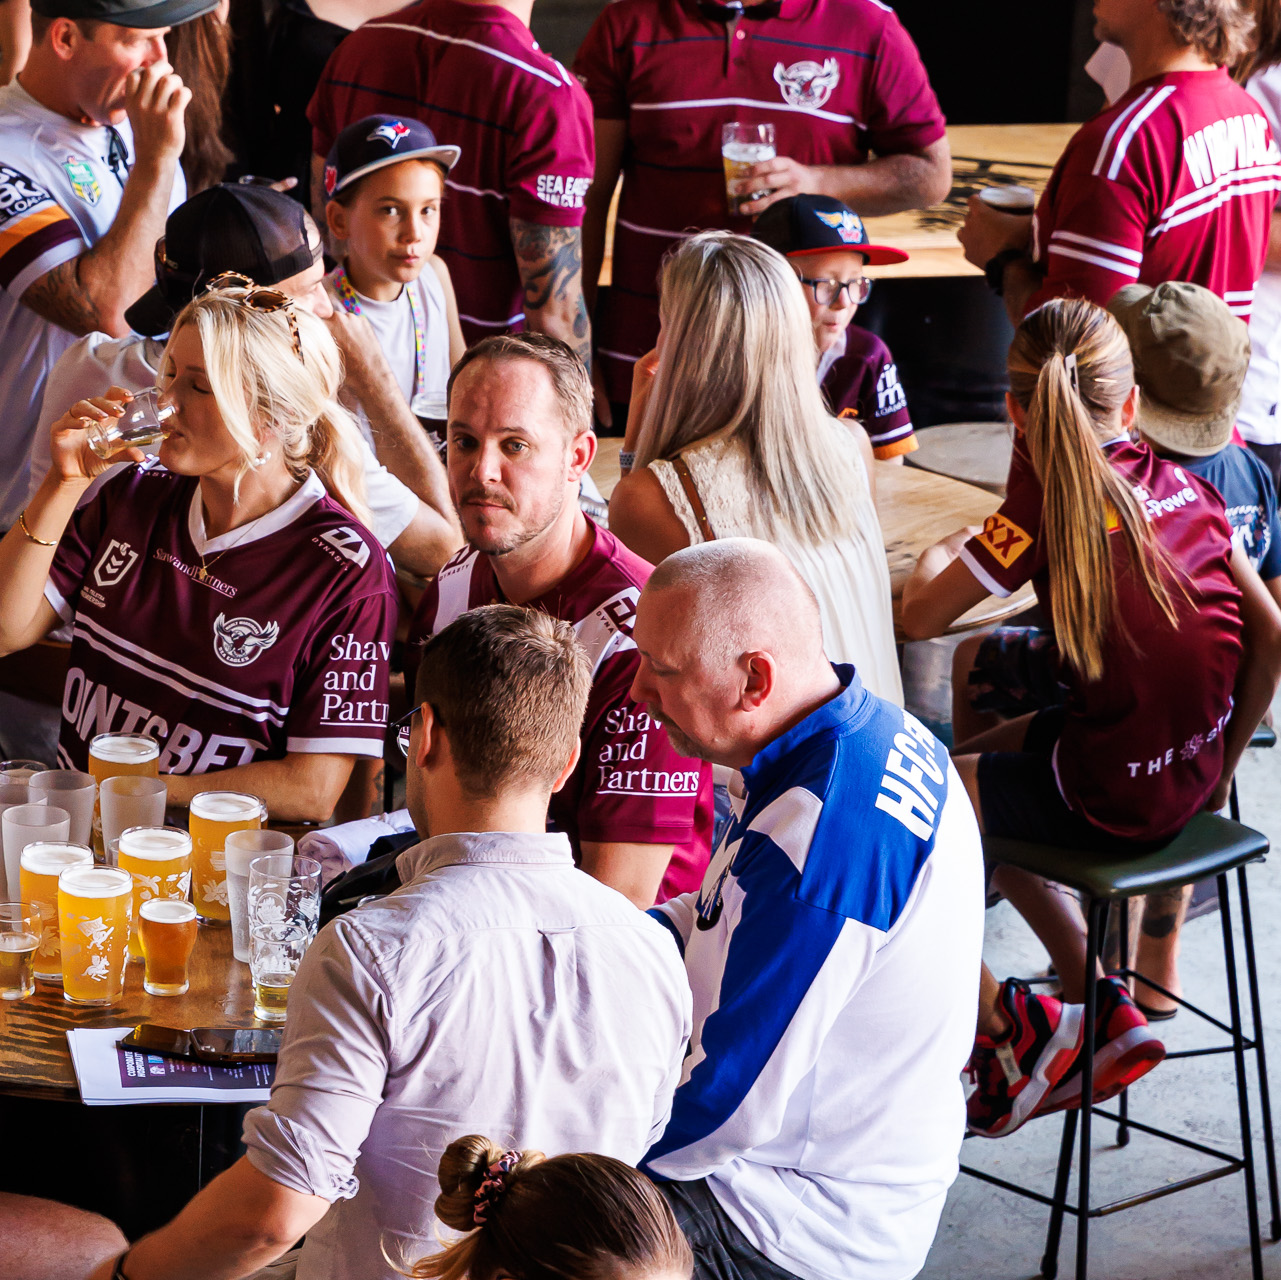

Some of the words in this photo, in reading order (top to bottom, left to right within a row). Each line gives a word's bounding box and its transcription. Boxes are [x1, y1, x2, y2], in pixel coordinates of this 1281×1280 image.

[536, 174, 564, 194] SEA
[311, 536, 349, 572] DYNASTY
[323, 664, 377, 692] and
[599, 733, 648, 763] and
[1127, 748, 1174, 778] THE
